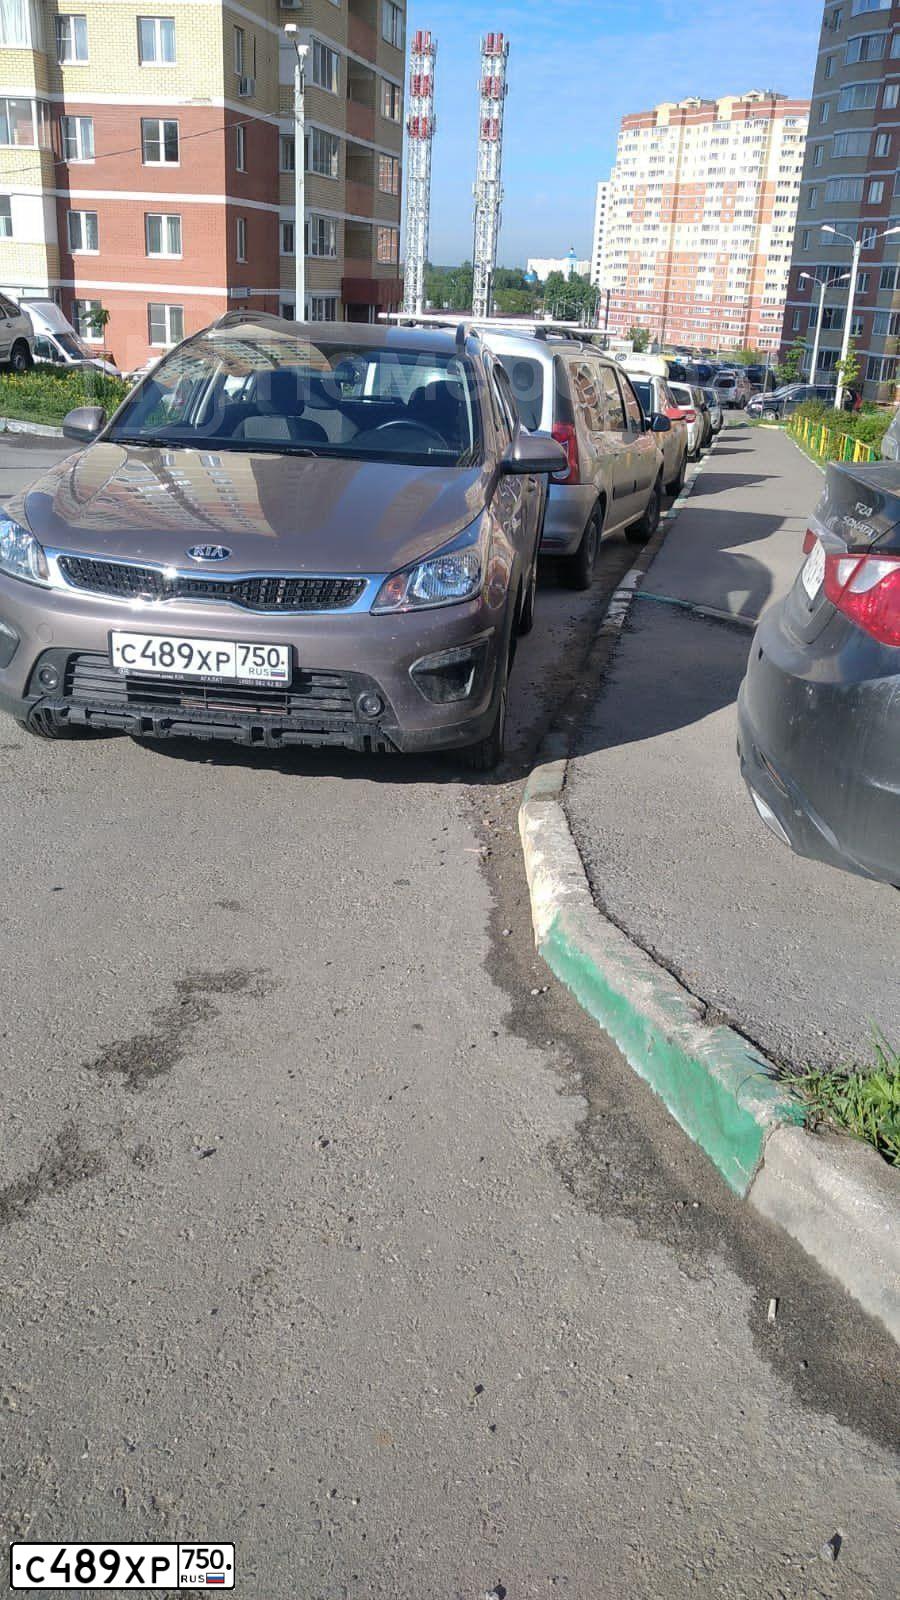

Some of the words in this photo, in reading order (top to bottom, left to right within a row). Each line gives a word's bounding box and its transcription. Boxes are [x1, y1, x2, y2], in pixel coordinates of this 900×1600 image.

[193, 546, 223, 557] KIA
[238, 645, 281, 668] 750
[248, 667, 269, 676] RUS
